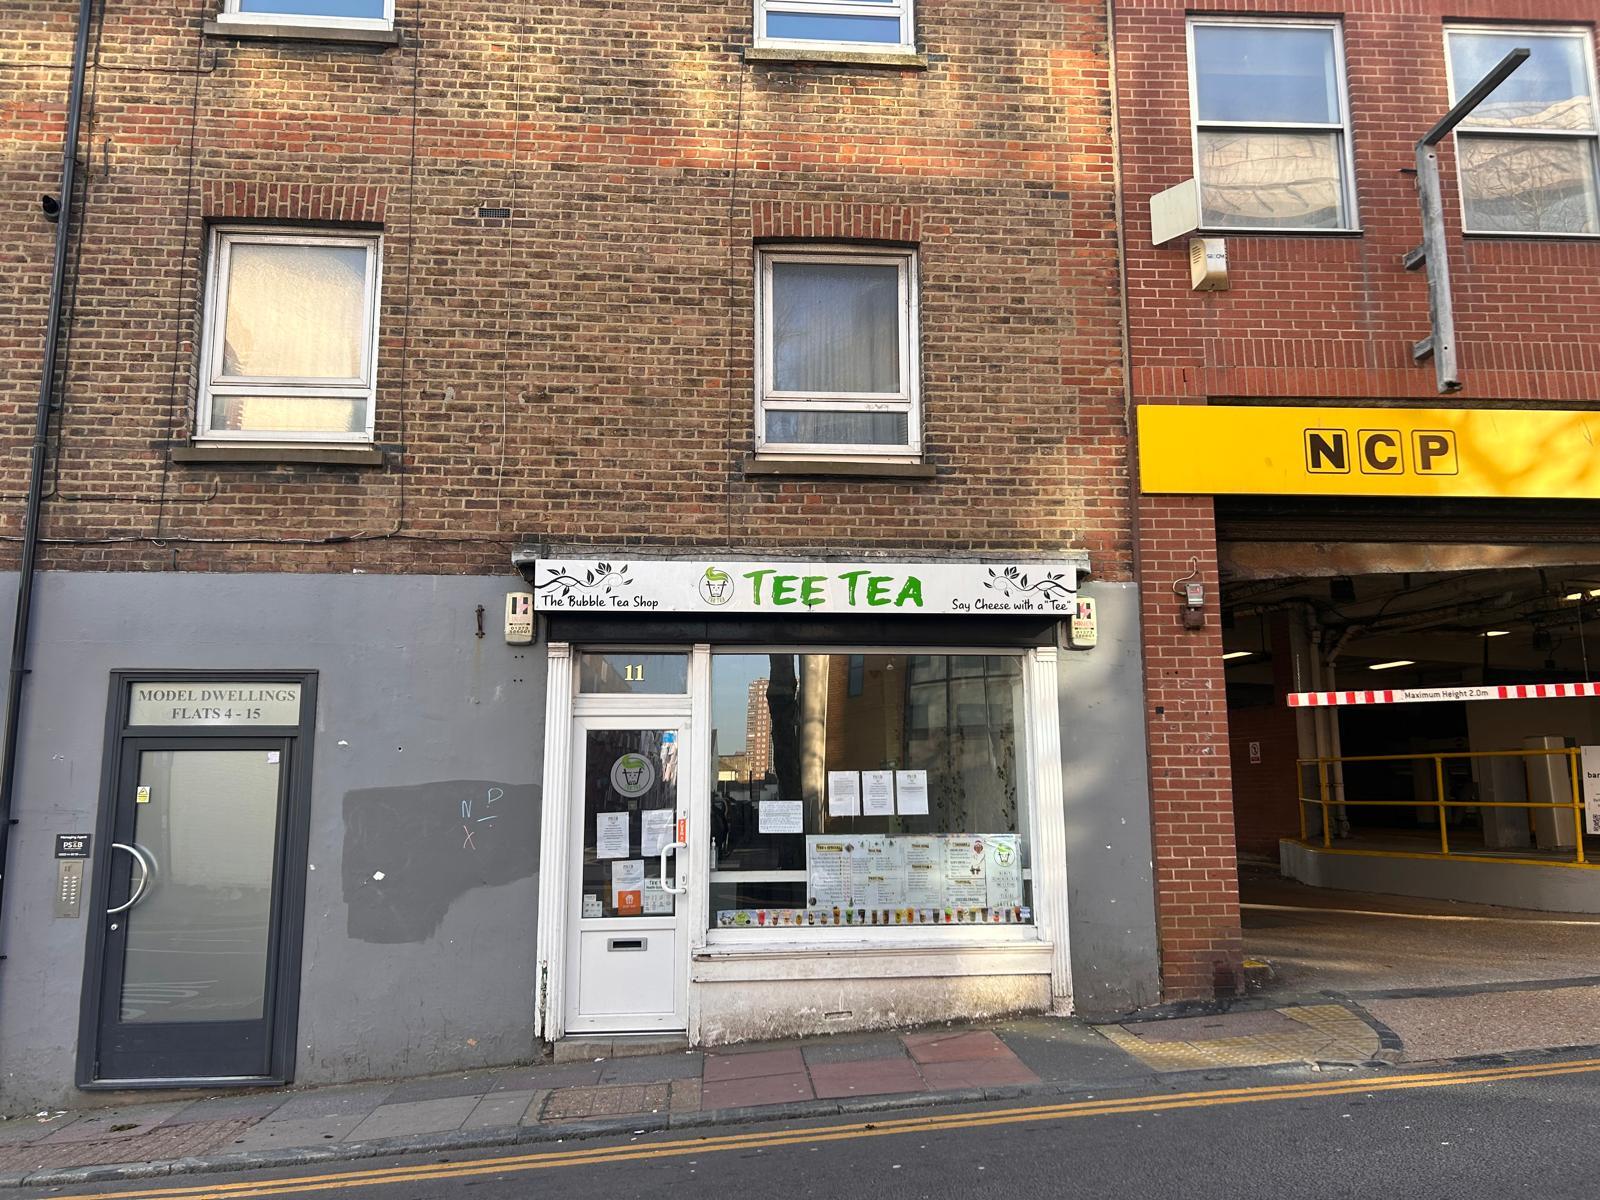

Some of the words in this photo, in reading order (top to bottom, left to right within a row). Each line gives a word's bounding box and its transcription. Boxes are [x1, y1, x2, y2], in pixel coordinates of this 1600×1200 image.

[1309, 433, 1450, 471] NCP
[743, 569, 827, 606] TEE
[838, 570, 924, 608] TEA
[541, 595, 565, 607] The
[567, 595, 606, 608] Bubble
[609, 595, 629, 607] Tea
[633, 595, 659, 609] Shop
[952, 598, 971, 611] Say
[974, 598, 1012, 610] Cheese
[1013, 598, 1035, 610] with
[1037, 602, 1044, 610] a
[624, 664, 644, 681] 11
[139, 690, 198, 702] MODEL
[201, 690, 296, 702] DWELLINGS
[1404, 690, 1440, 699] Maximum
[1441, 689, 1468, 699] Height
[1469, 688, 1489, 697] 2.0m
[172, 707, 221, 720] FLATS
[224, 708, 232, 719] 4
[246, 707, 262, 720] 15
